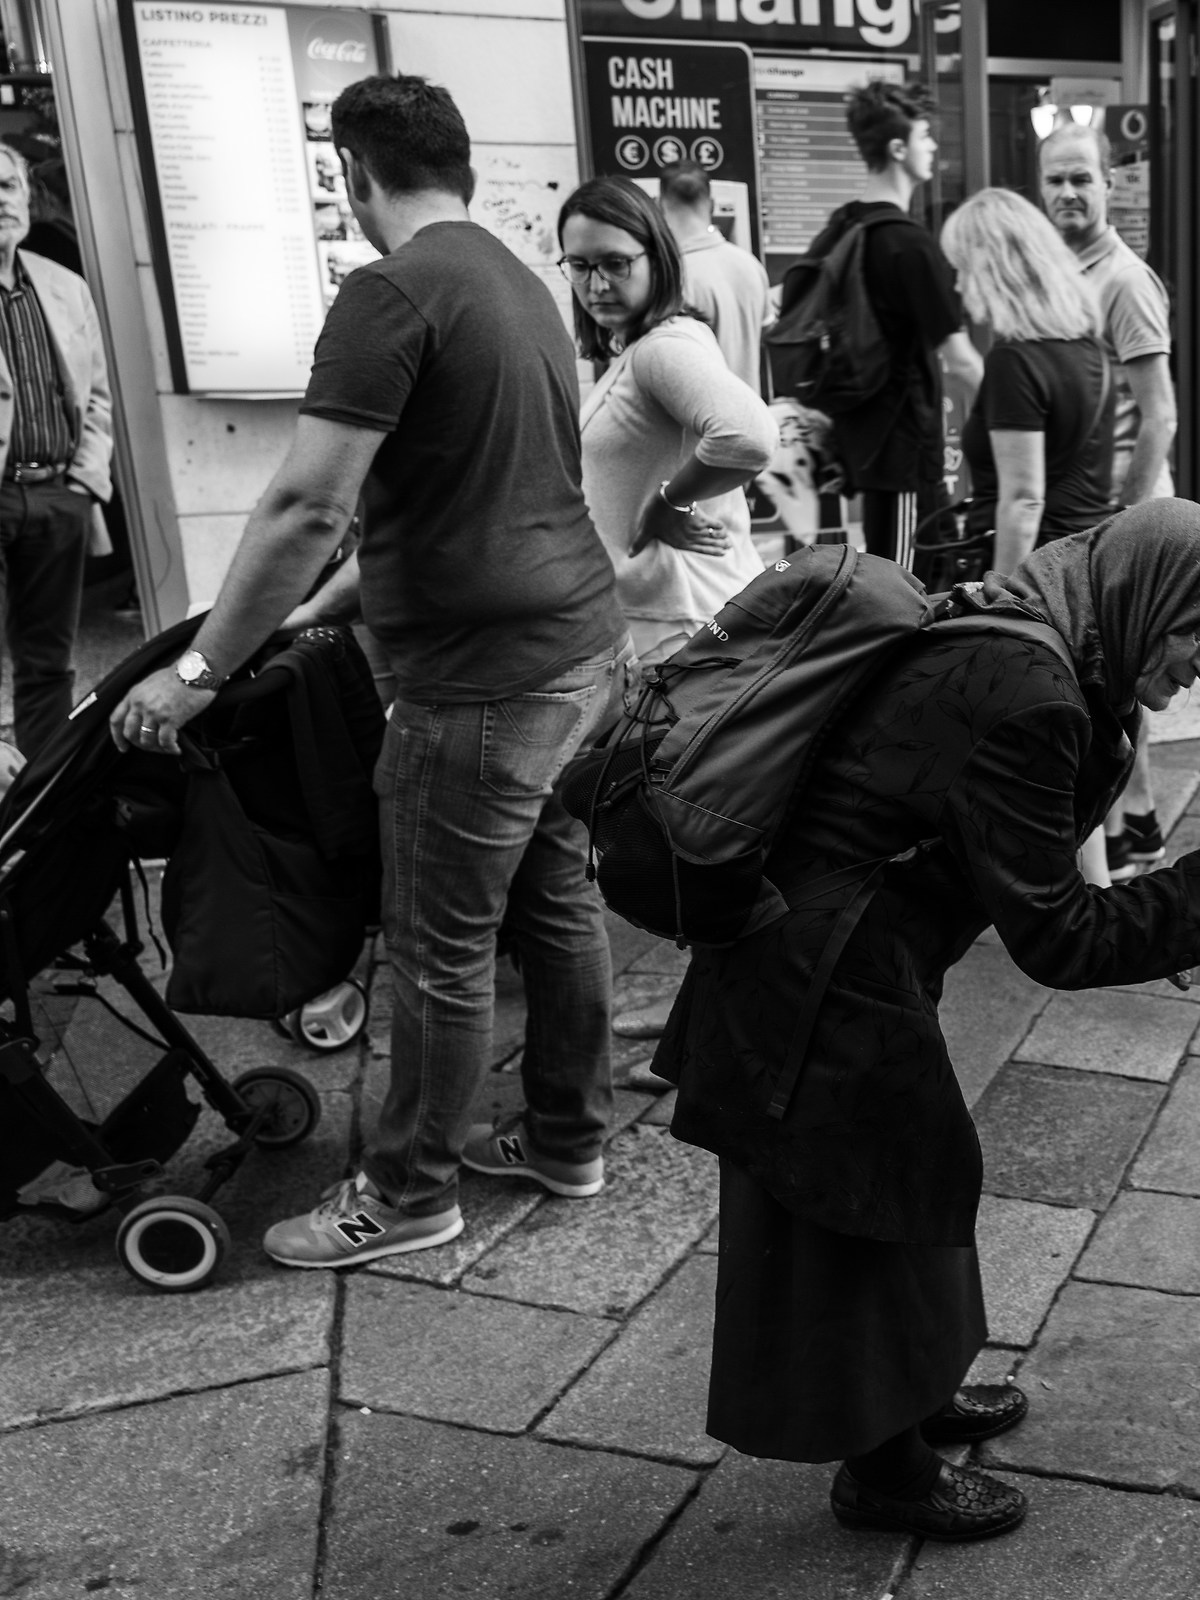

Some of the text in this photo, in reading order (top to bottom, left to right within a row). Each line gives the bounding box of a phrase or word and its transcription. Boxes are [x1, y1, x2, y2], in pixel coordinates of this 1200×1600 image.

[141, 9, 268, 27] LISTINO PREZZI
[142, 39, 213, 48] CAFFETTERIA
[608, 56, 674, 90] CASH
[611, 96, 722, 129] MACHINE
[496, 1135, 528, 1165] N
[333, 1210, 387, 1249] N
